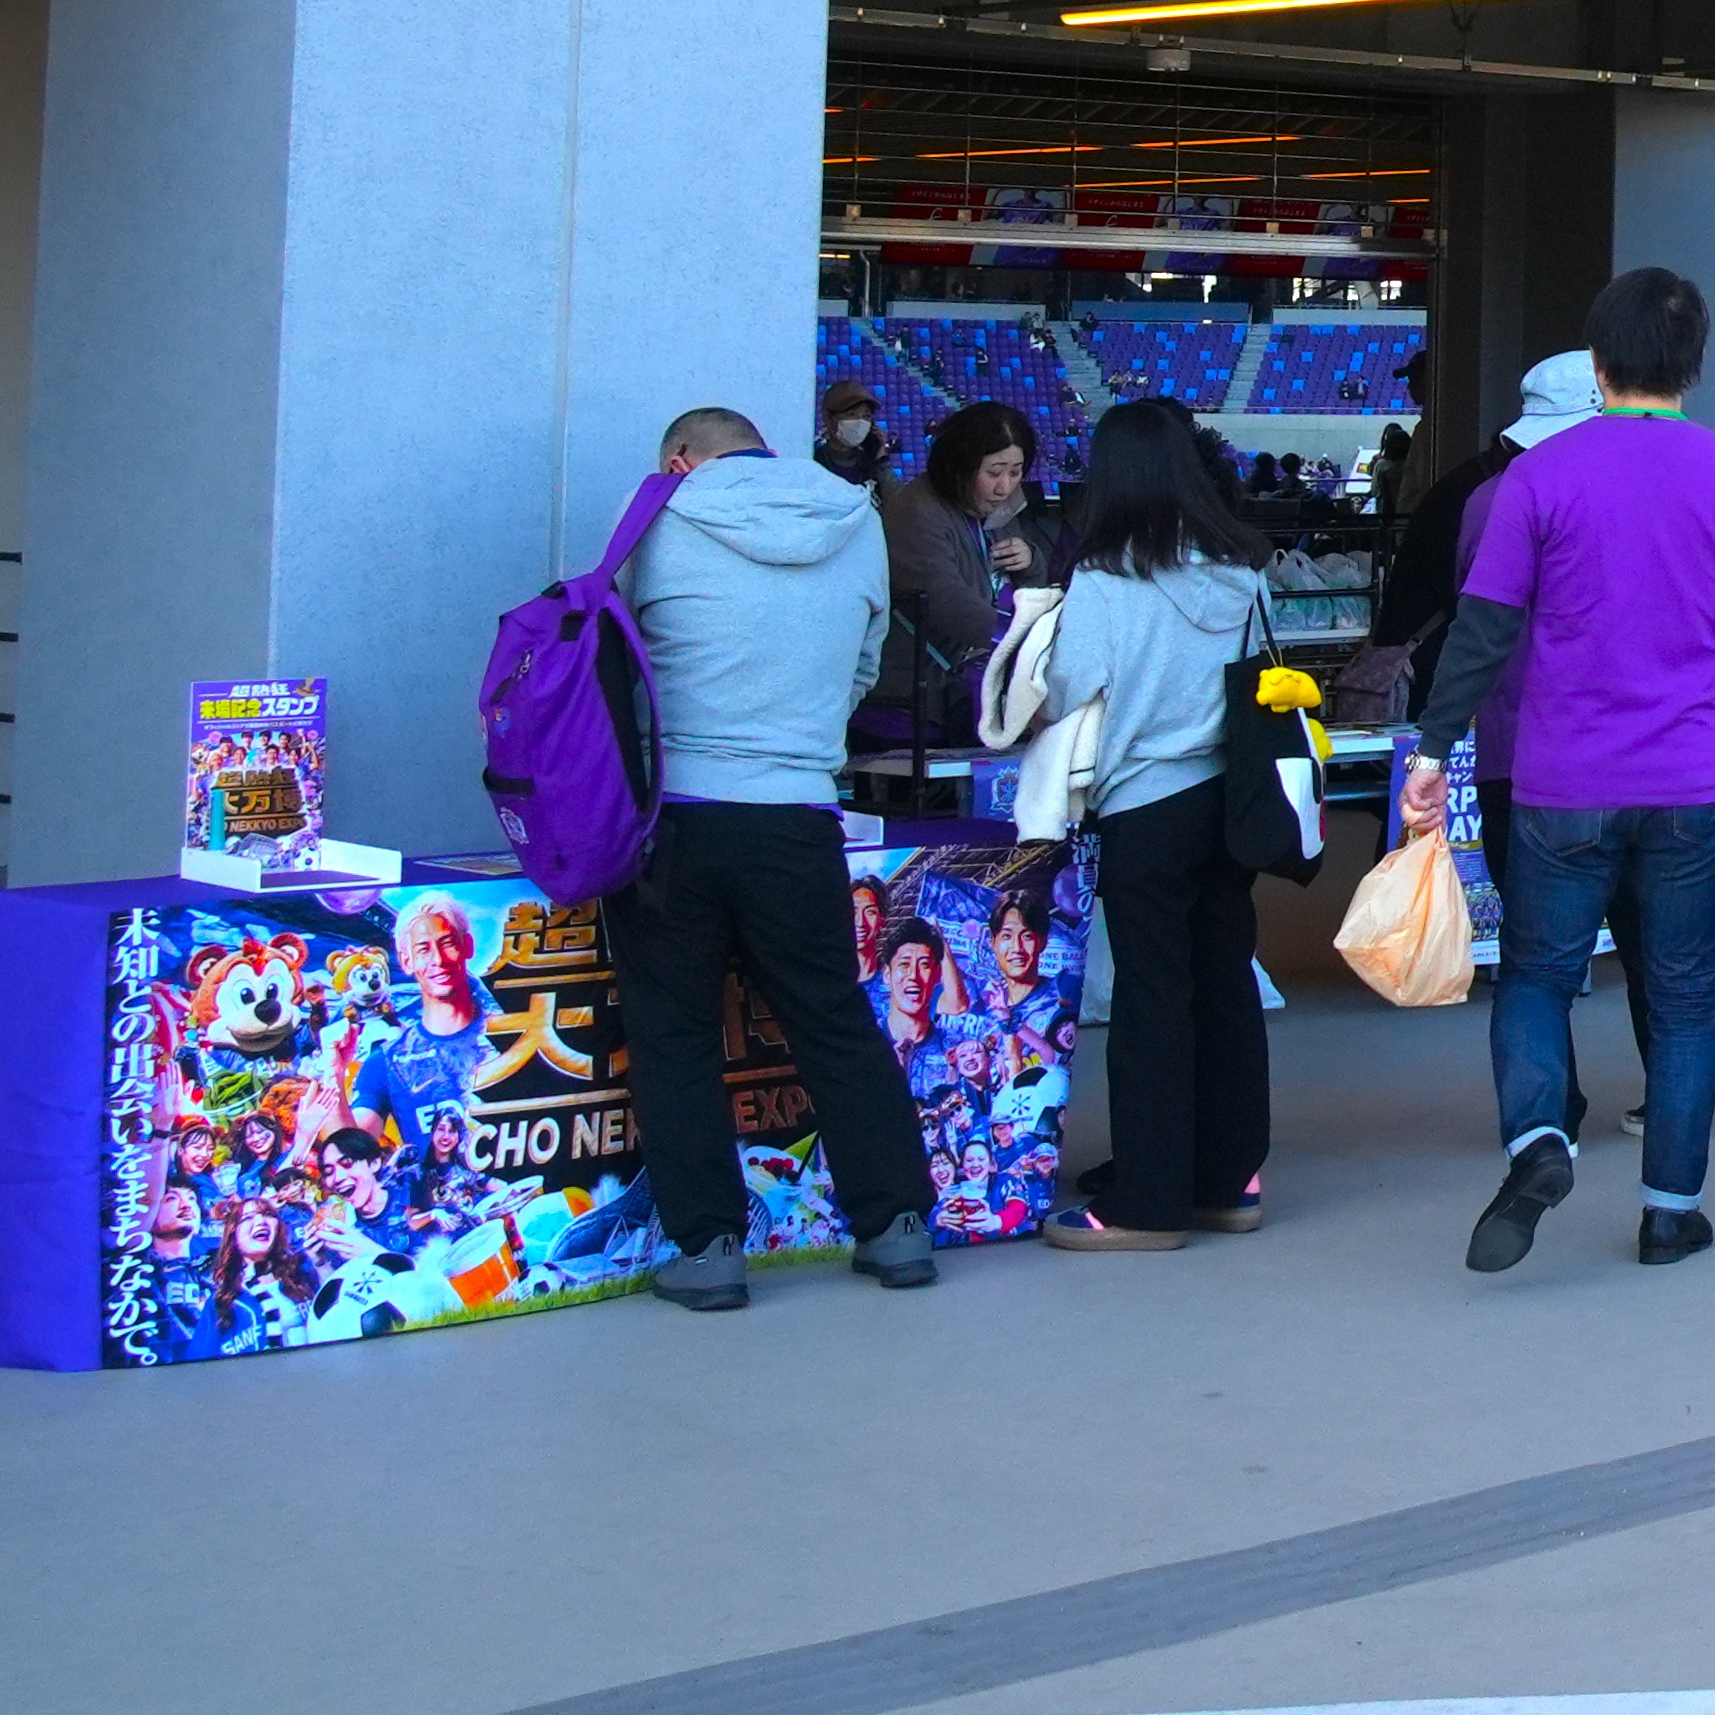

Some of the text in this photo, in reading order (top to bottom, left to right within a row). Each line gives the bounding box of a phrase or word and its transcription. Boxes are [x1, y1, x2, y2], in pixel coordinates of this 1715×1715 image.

[230, 820, 277, 833] NEKKYO
[1446, 813, 1482, 843] AY
[108, 907, 162, 1366] 未知との出会いをまちなかで。
[466, 1116, 561, 1172] CHO
[731, 1085, 816, 1135] EXP
